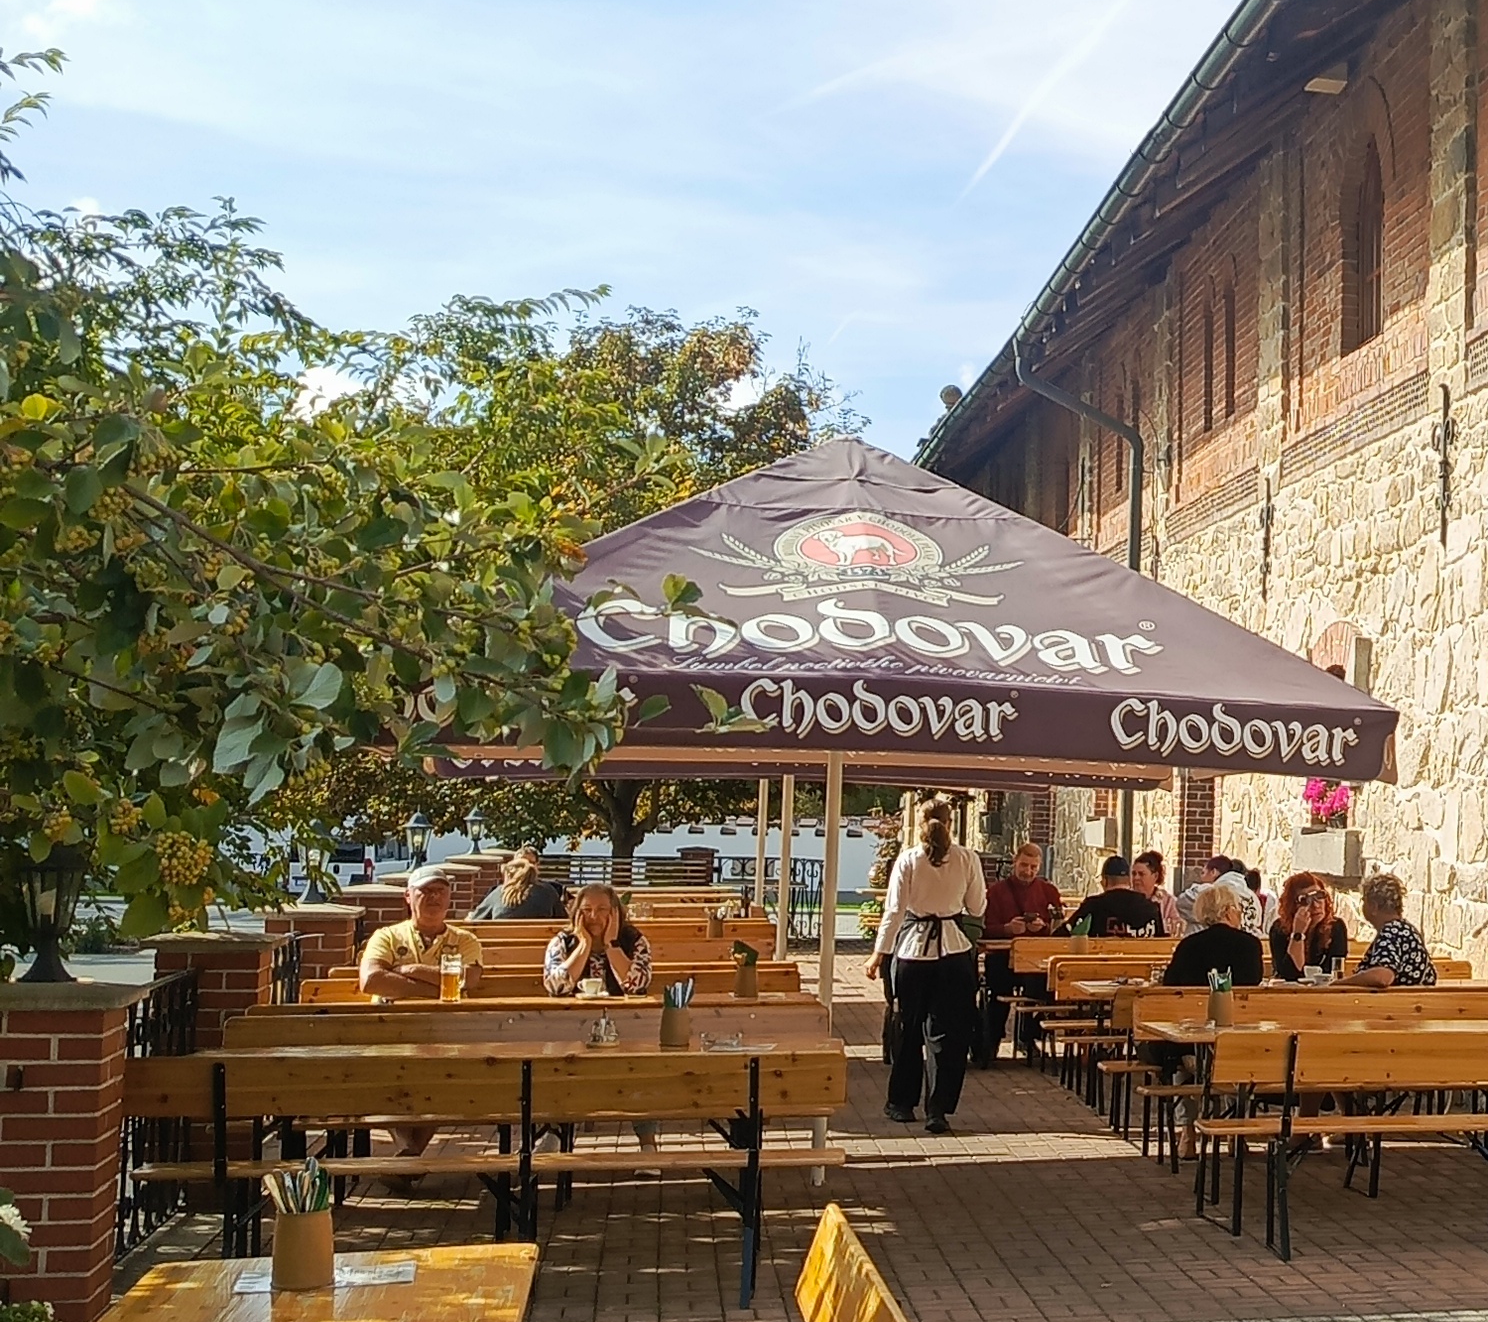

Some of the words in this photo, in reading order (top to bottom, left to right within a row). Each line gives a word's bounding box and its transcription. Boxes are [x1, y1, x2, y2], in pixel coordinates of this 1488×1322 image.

[576, 596, 1164, 676] Chodovar
[740, 678, 1019, 743] Chodovar
[1110, 697, 1360, 767] Chodovar
